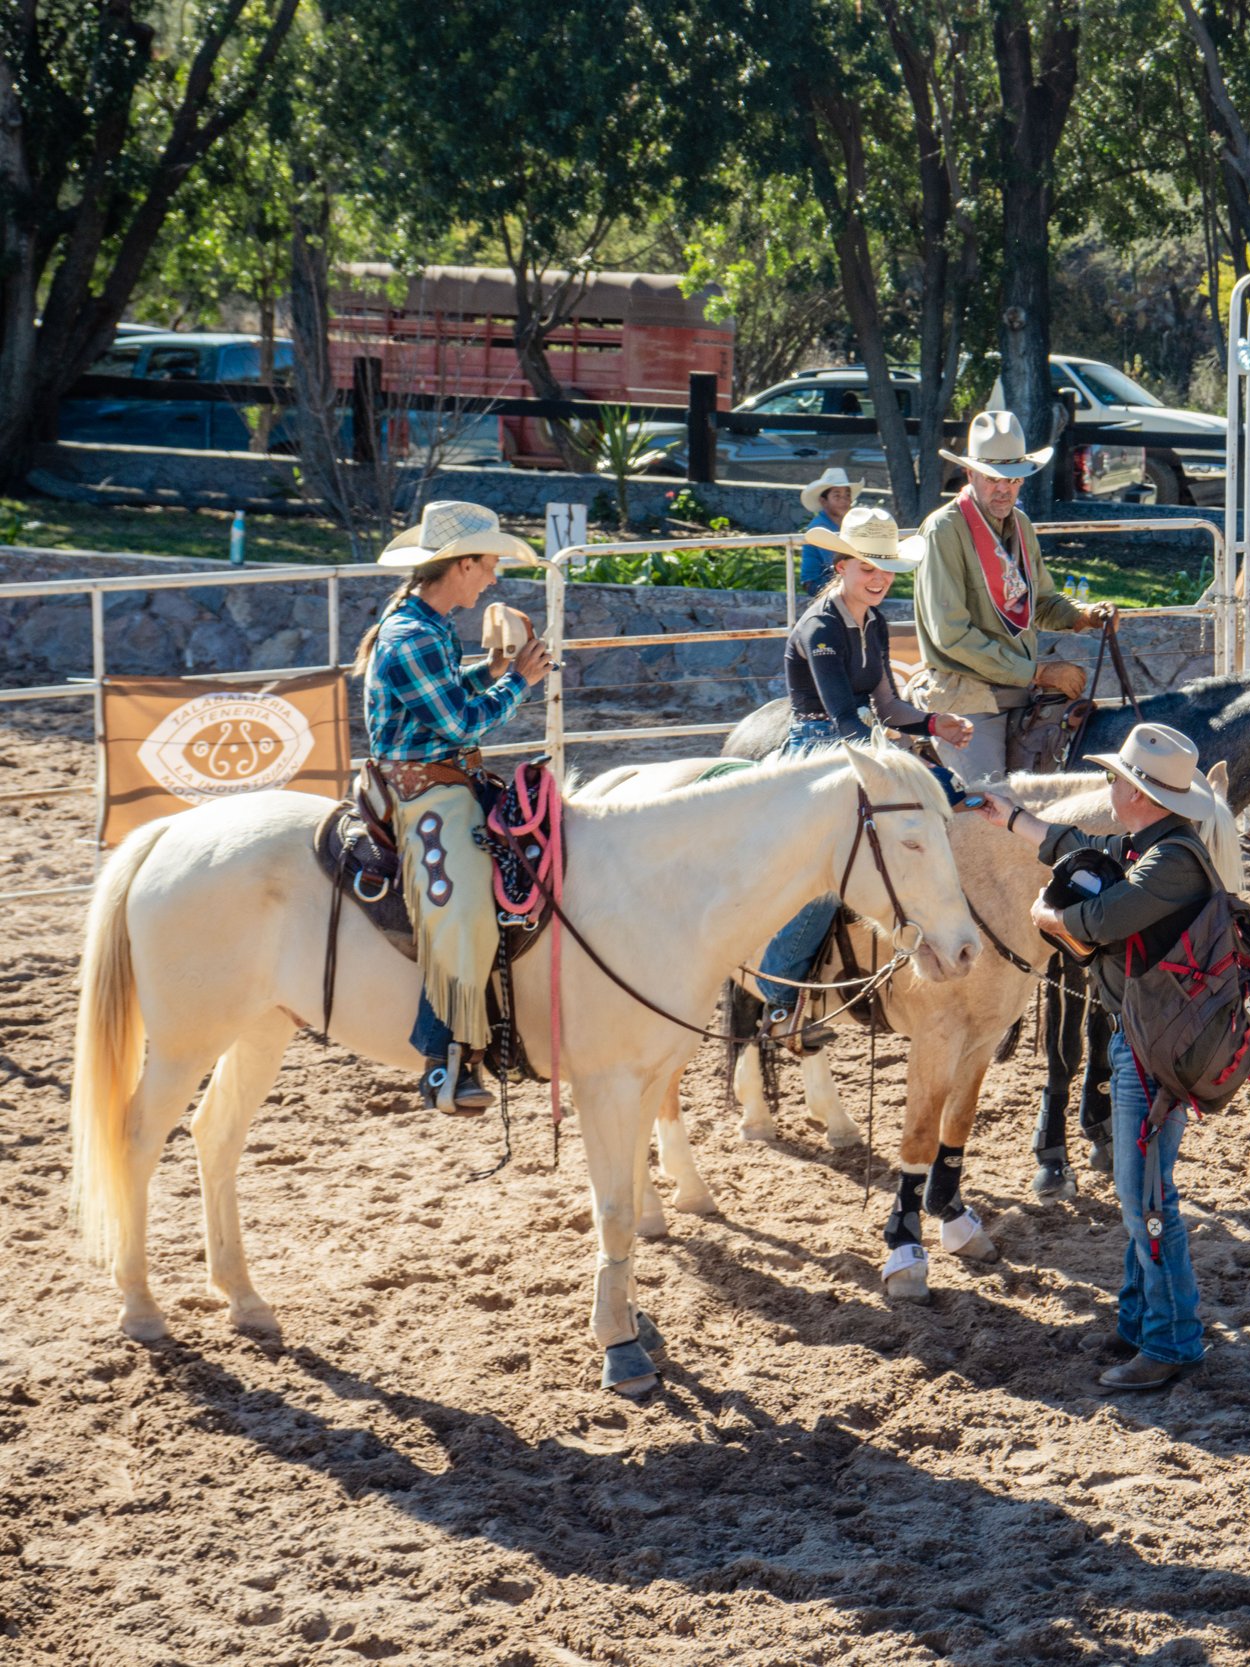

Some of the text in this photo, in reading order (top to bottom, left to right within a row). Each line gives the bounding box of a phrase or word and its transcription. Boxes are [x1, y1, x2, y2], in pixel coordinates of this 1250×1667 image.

[197, 707, 271, 725] TENERIA
[175, 756, 288, 794] LA INDUSTRIAL
